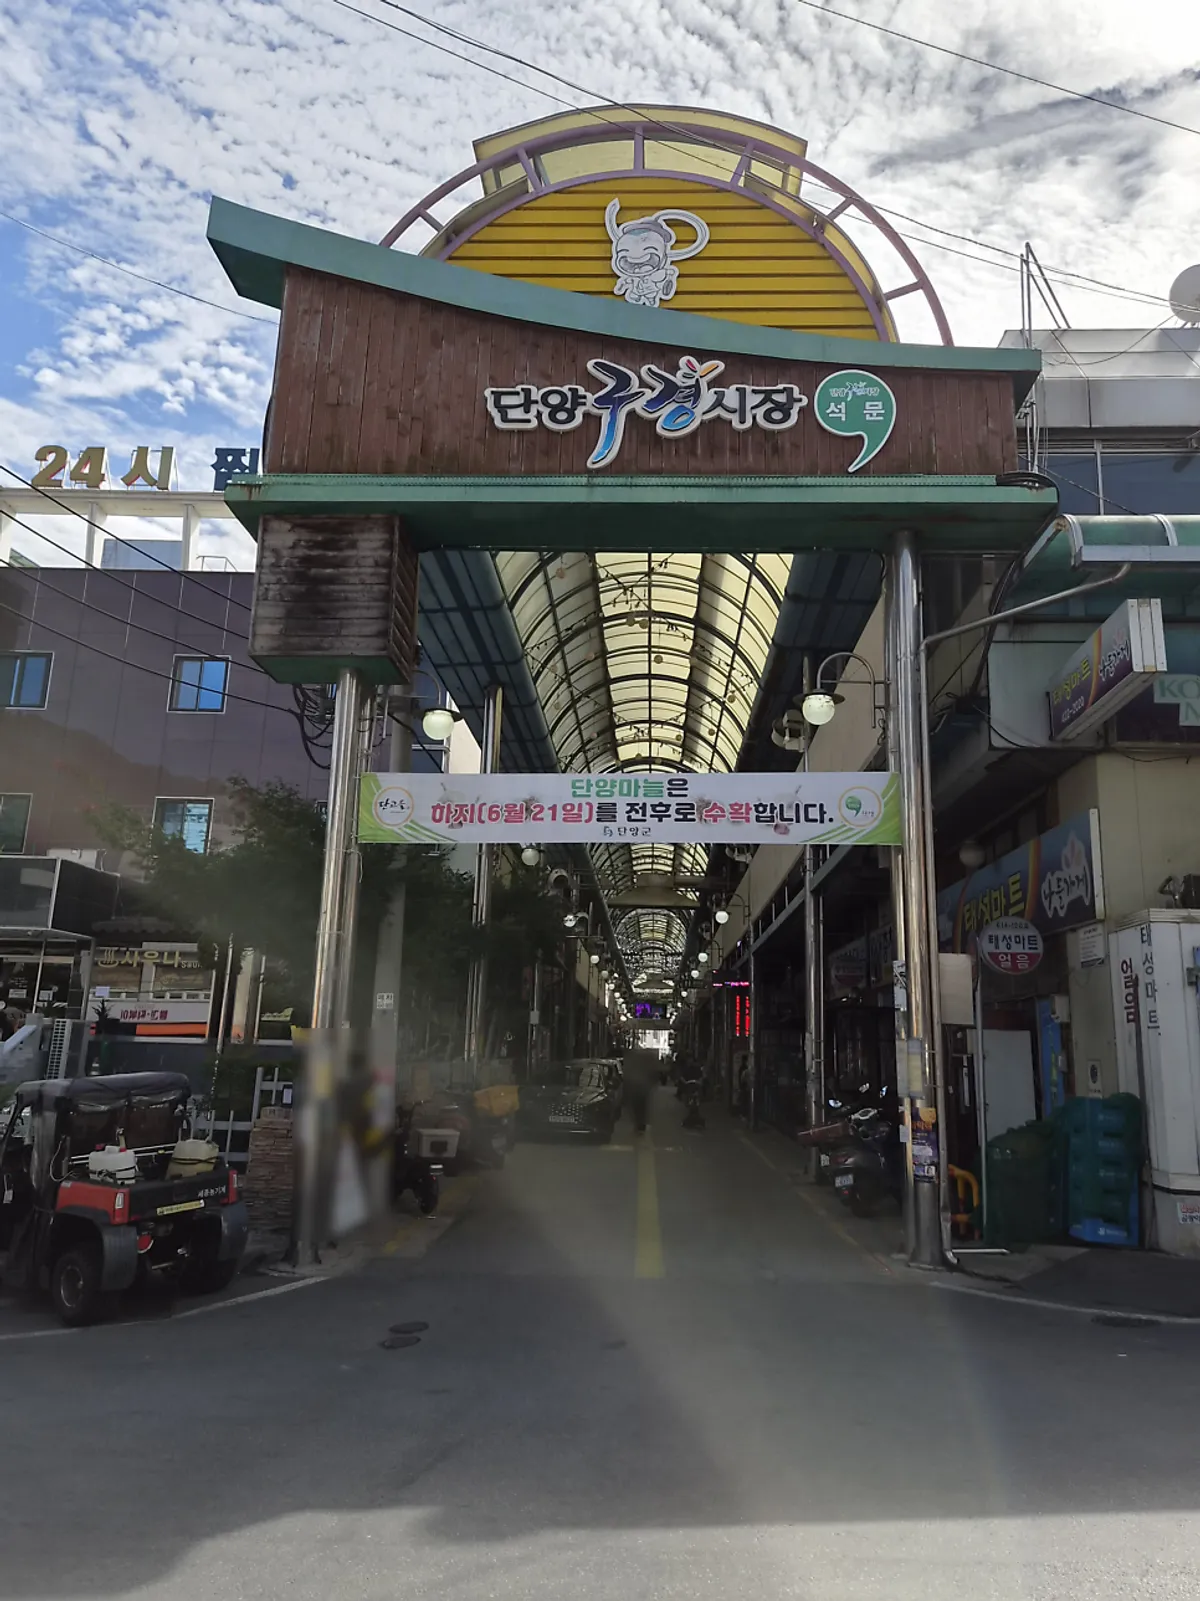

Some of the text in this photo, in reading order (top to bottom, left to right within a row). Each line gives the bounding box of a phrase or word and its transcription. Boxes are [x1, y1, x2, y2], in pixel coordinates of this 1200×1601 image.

[31, 445, 174, 490] 24시
[571, 778, 688, 798] 단양마늘은
[625, 802, 697, 824] 전후로
[703, 802, 834, 824] 수확합니다.
[617, 826, 651, 837] 단양군
[963, 873, 1025, 930] 태성마트
[988, 934, 1039, 950] 태성마트
[121, 950, 179, 968] 사우나
[998, 953, 1030, 969] 얼음
[1140, 923, 1160, 1029] 태성마트
[1121, 958, 1138, 1024] 얼음
